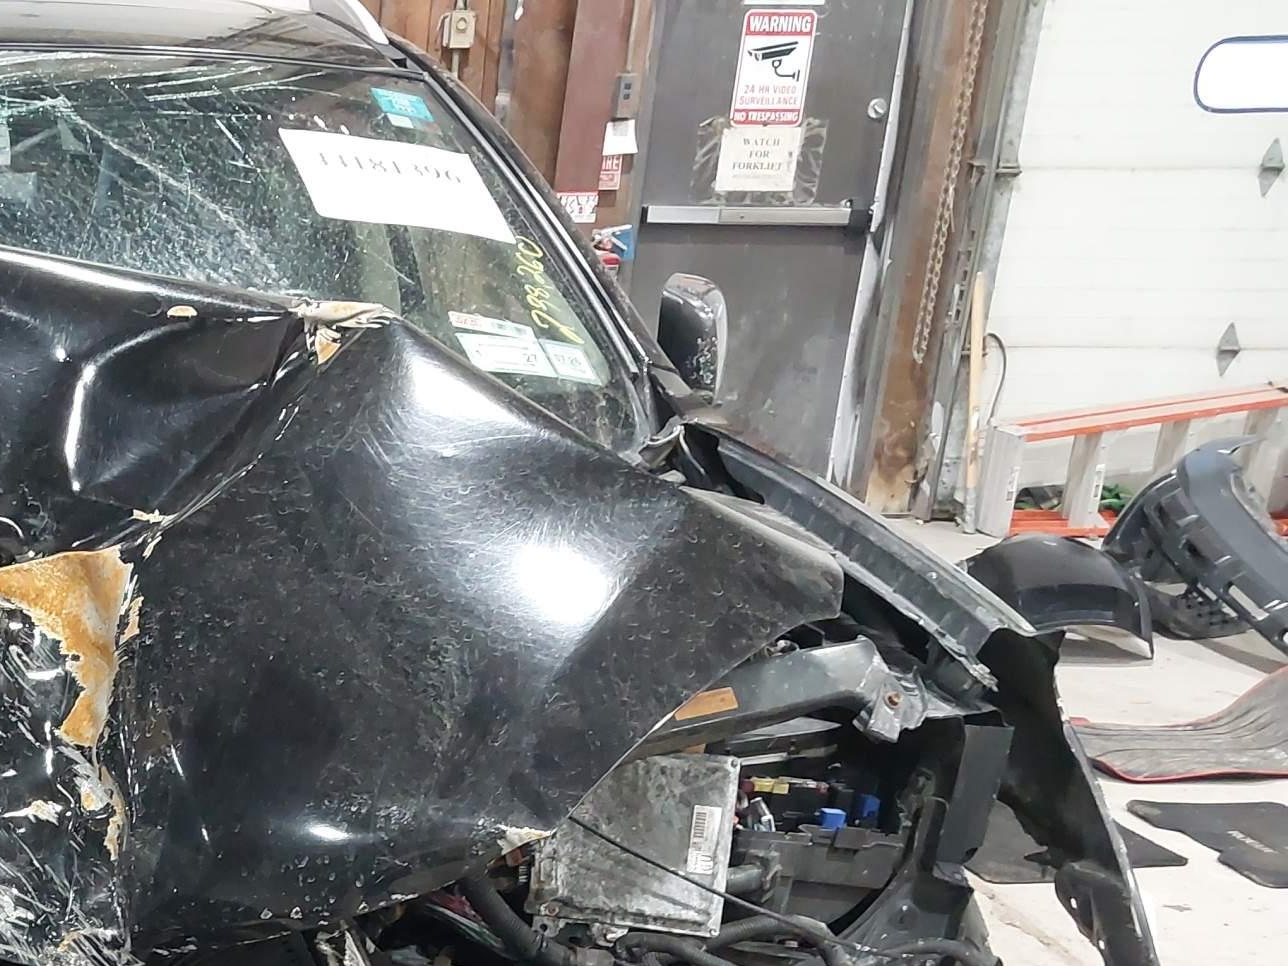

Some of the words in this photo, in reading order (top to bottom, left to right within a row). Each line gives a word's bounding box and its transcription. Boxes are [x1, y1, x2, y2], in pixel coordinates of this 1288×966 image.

[749, 15, 812, 33] WARNING
[743, 84, 755, 95] 24
[773, 84, 798, 95] VIDEO
[739, 95, 799, 106] SURVEILLANCE
[734, 111, 747, 122] NO
[748, 111, 799, 122] TRESPASSING
[743, 137, 781, 147] WATCH
[749, 149, 770, 159] FOR
[601, 154, 621, 171] IRE
[732, 161, 783, 171] FORKLIFT
